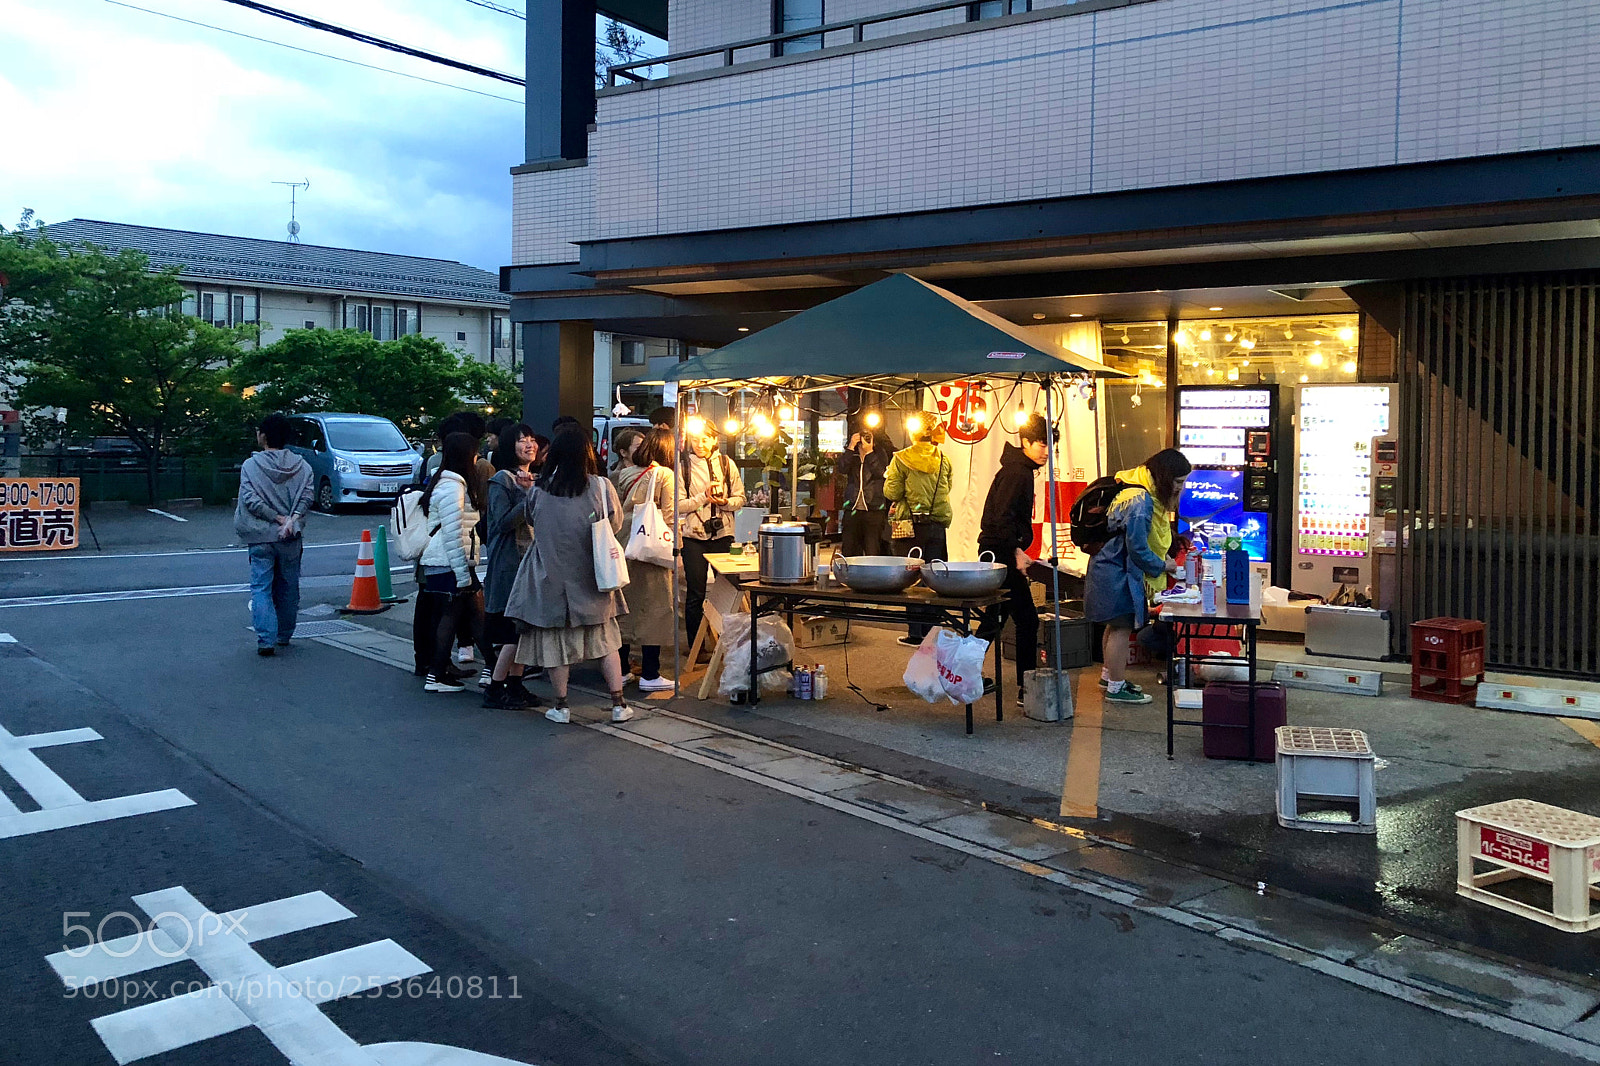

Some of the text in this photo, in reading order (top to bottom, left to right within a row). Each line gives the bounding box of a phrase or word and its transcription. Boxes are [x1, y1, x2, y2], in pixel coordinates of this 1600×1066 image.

[1482, 841, 1548, 870] アサヒビール
